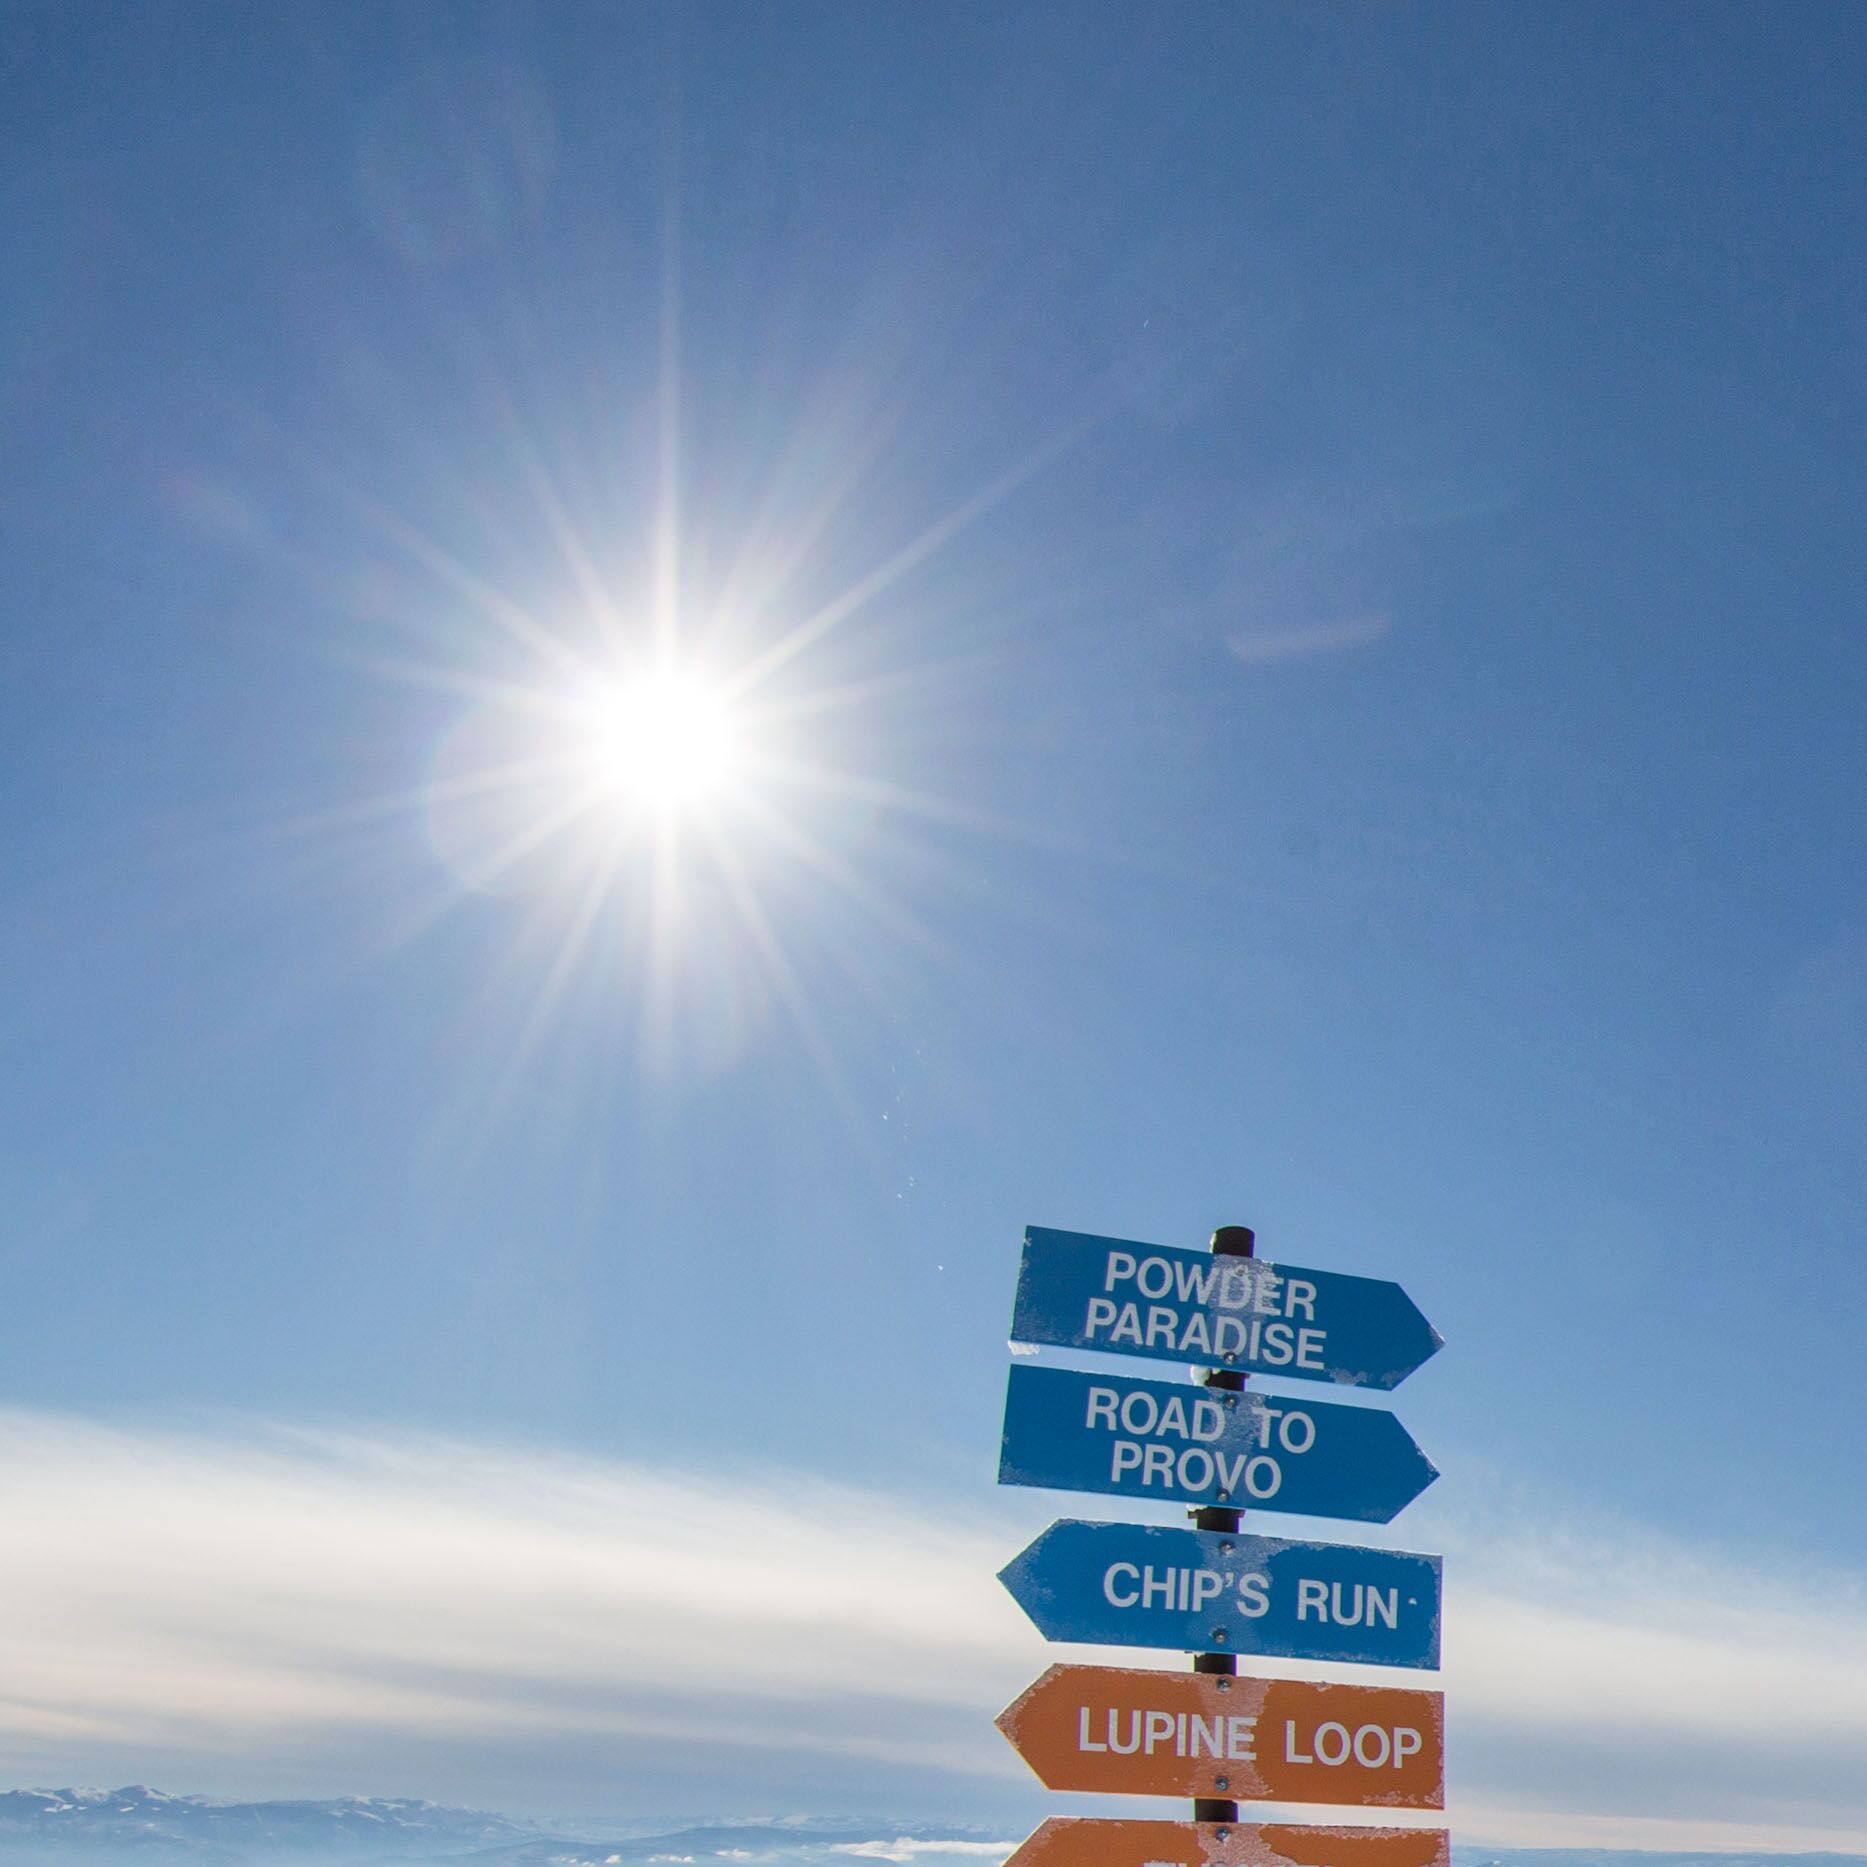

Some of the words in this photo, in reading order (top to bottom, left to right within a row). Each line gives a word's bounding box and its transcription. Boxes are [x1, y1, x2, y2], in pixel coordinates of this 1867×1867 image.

[1104, 1251, 1317, 1321] POWDER
[1084, 1297, 1327, 1370] PARADISE
[1085, 1386, 1226, 1442] ROAD
[1252, 1407, 1316, 1454] TO
[1111, 1440, 1282, 1499] PROVO
[1103, 1562, 1270, 1618] CHIP'S
[1296, 1577, 1398, 1629] RUN
[1077, 1706, 1258, 1761] LUPINE
[1285, 1720, 1422, 1769] LOOP
